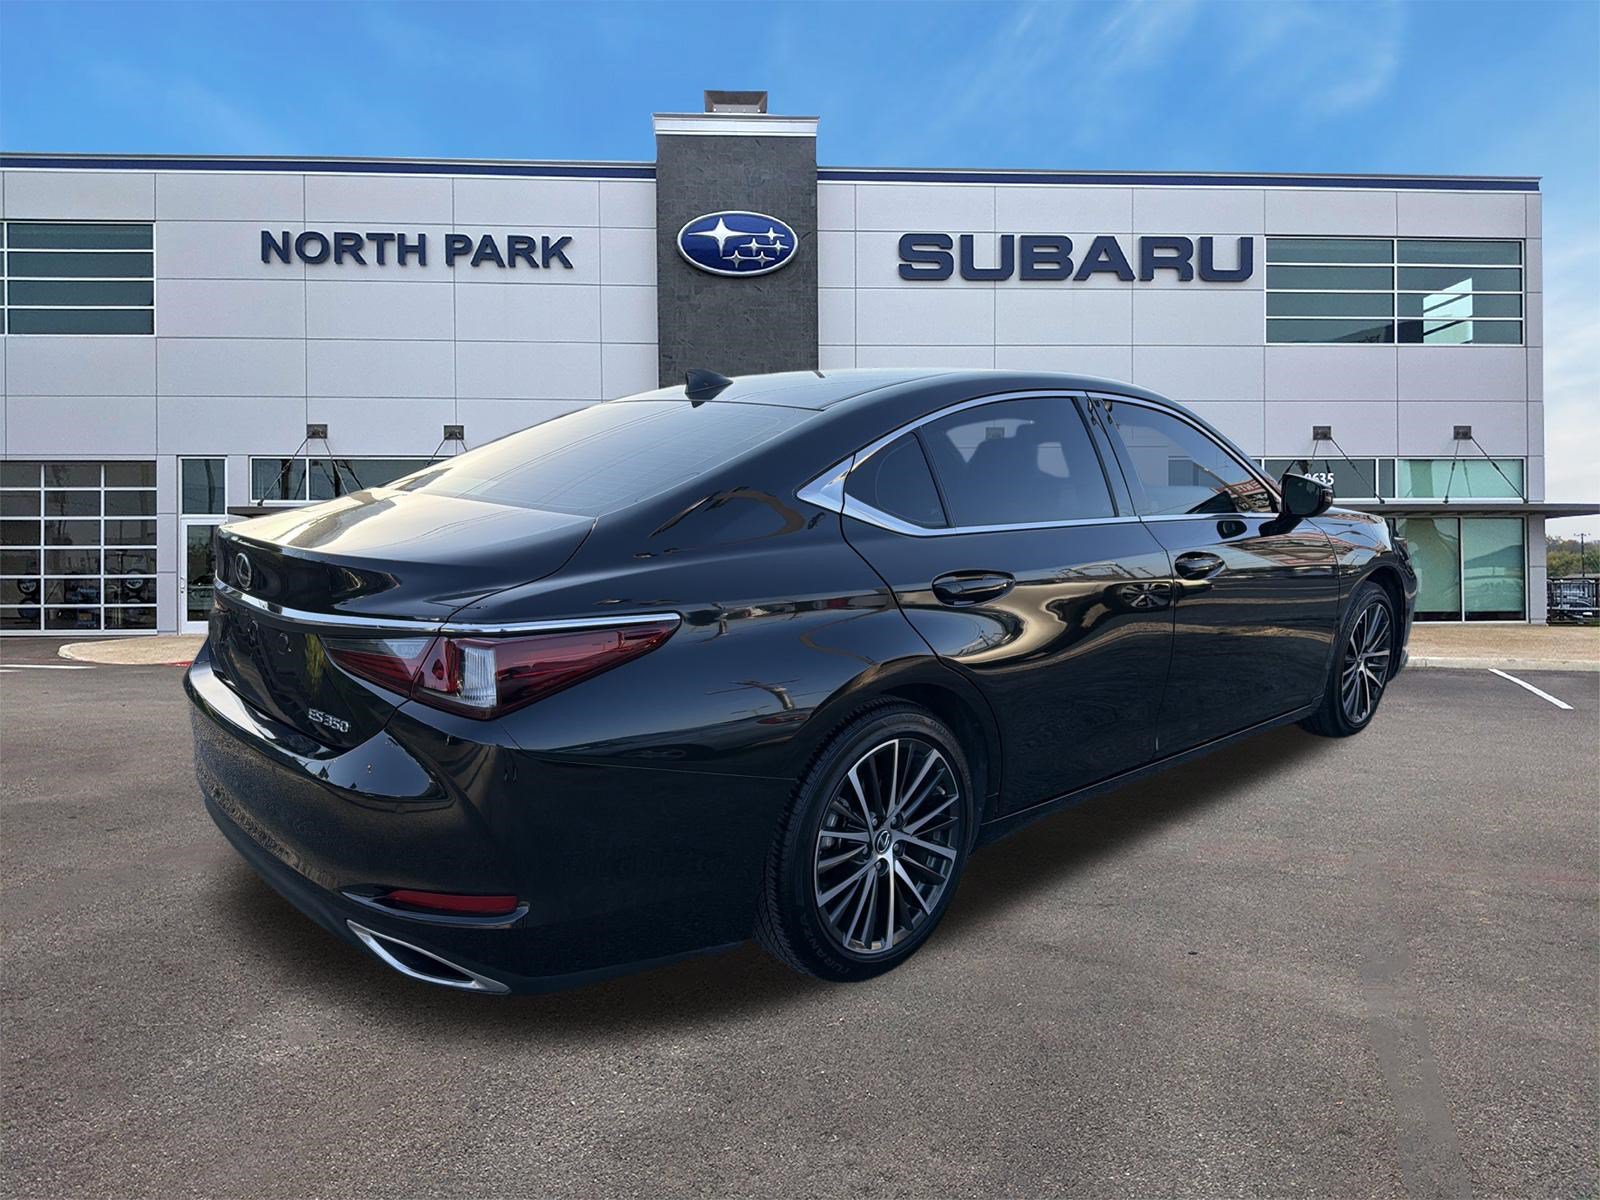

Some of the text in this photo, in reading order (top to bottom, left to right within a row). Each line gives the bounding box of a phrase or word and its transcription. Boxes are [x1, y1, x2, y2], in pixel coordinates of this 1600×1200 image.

[261, 230, 574, 269] NORTH PARK
[898, 232, 1254, 282] SUBARU
[308, 708, 349, 733] ES 350
